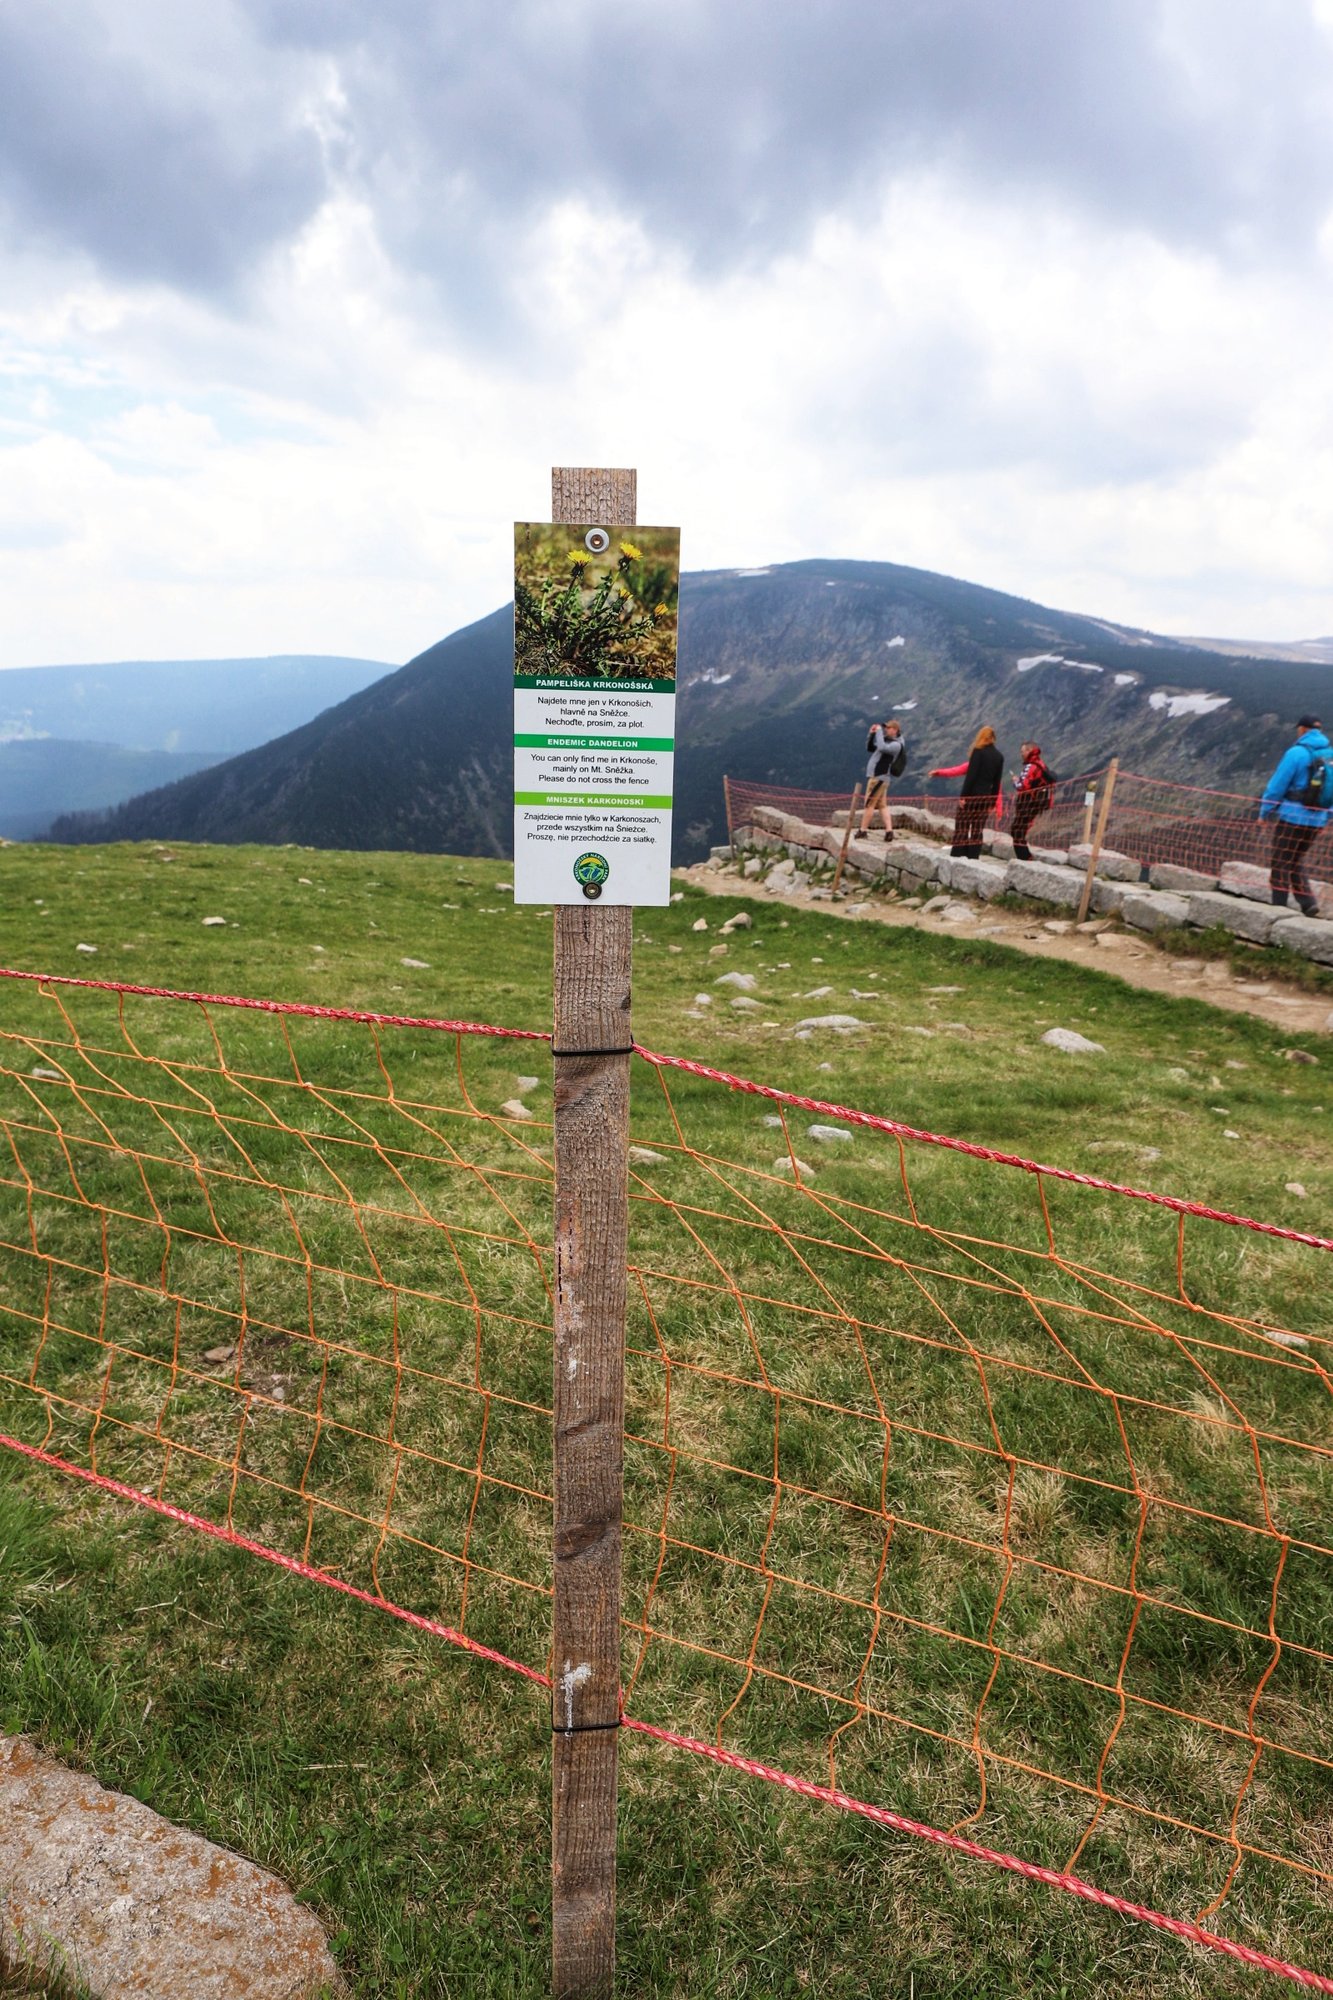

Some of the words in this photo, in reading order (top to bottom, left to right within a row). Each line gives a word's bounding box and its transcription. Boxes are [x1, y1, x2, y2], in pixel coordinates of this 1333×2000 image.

[593, 681, 653, 690] KRKONOŠSKÁ
[538, 697, 567, 705] Najdete
[588, 698, 599, 707] jen
[620, 757, 657, 765] Krkonoše,
[553, 765, 577, 774] mainly
[524, 813, 563, 821] Znajdziecie
[610, 815, 661, 824] Karkonoszach,
[528, 833, 555, 842] Proszę,
